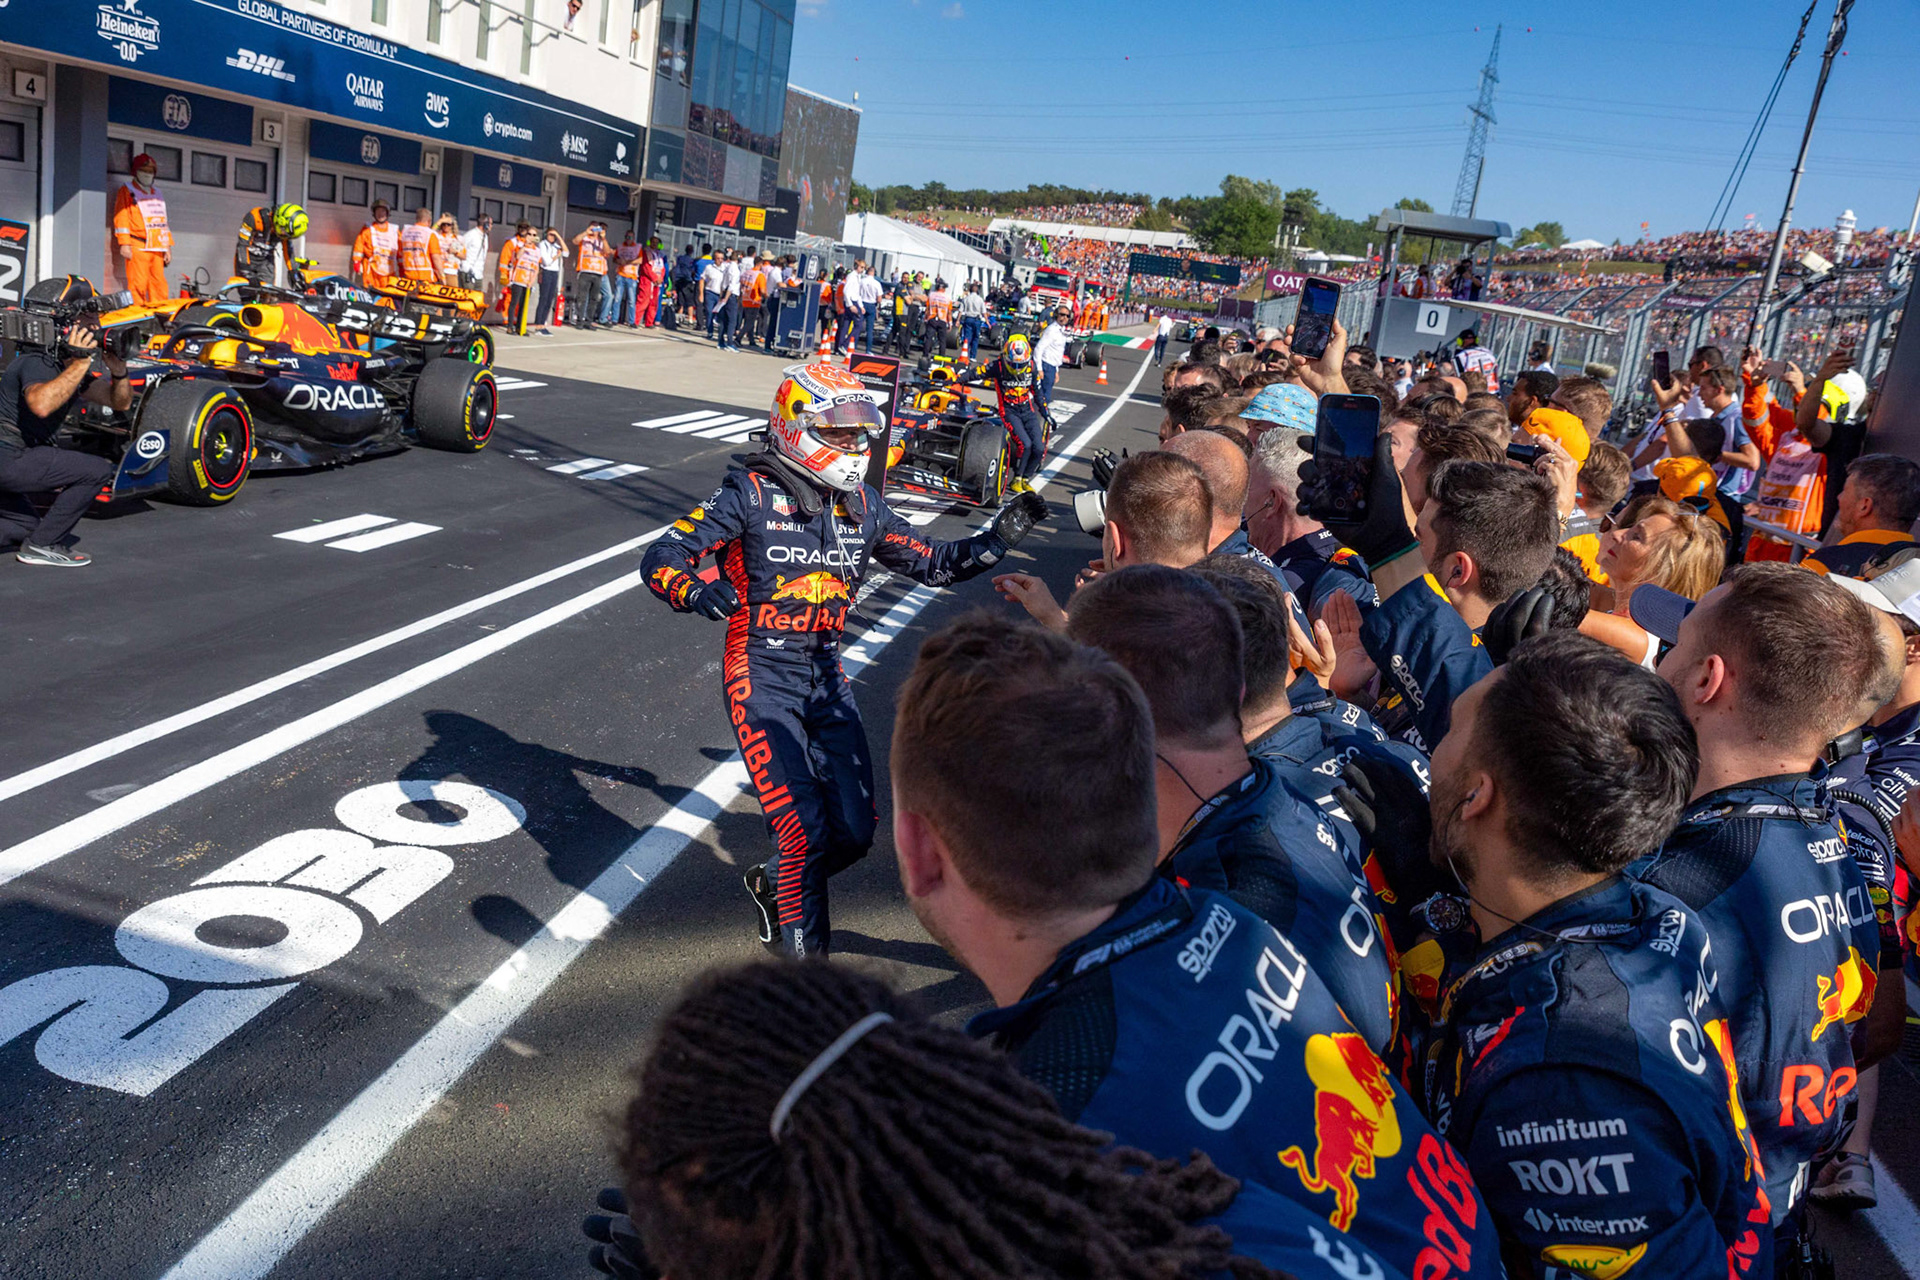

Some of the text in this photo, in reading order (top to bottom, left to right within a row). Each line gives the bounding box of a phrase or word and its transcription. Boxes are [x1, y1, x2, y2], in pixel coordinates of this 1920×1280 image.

[100, 12, 158, 42] Heineken
[238, 0, 281, 23] GLOBAL
[282, 11, 332, 39] PARTNERS
[333, 27, 347, 43] OF
[347, 32, 389, 57] FORMULA
[120, 41, 137, 62] 0.0
[236, 48, 290, 80] DHL
[26, 78, 36, 94] 4
[346, 73, 384, 99] QATAR
[354, 95, 384, 112] AIRWAYS
[425, 91, 449, 115] aws
[268, 121, 275, 138] 3
[494, 121, 533, 141] crypto.com
[570, 135, 589, 154] MSC
[1273, 274, 1303, 290] QAT
[1427, 310, 1439, 328] 0
[283, 384, 385, 411] ORACLE
[779, 417, 803, 447] Bull
[766, 520, 794, 531] Mobil
[885, 533, 909, 546] GIVES
[766, 546, 862, 565] ORACLE
[756, 604, 848, 632] Red Bull
[1390, 654, 1425, 712] sparco
[727, 677, 793, 814] Red Bull
[1781, 883, 1877, 943] ORACL
[1177, 903, 1237, 980] sparco
[1669, 932, 1718, 1075] ORAC
[1779, 1064, 1857, 1126] Re
[1496, 1117, 1627, 1148] infinitum
[1508, 1153, 1635, 1196] ROKT
[1554, 1213, 1650, 1236] inter.mx
